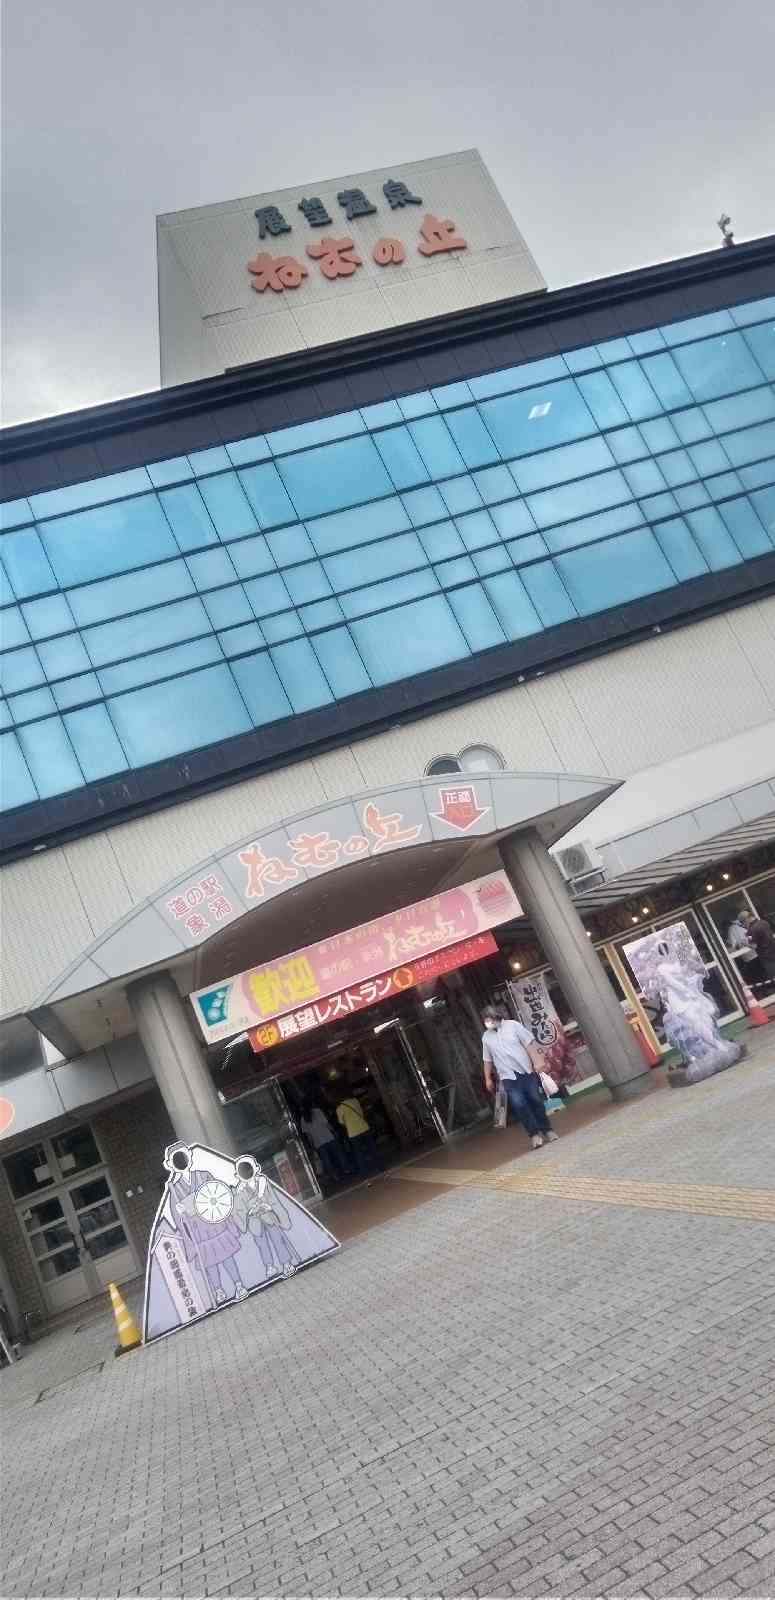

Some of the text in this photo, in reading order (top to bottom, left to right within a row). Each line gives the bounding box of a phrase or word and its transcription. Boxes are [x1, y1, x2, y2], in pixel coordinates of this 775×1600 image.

[254, 179, 422, 240] 展望温泉
[247, 213, 468, 293] ねむの丘
[238, 801, 423, 898] ねむの丘
[166, 874, 224, 918] 道の駅
[186, 898, 233, 938] 象潟
[278, 976, 393, 1038] 展望レストラン
